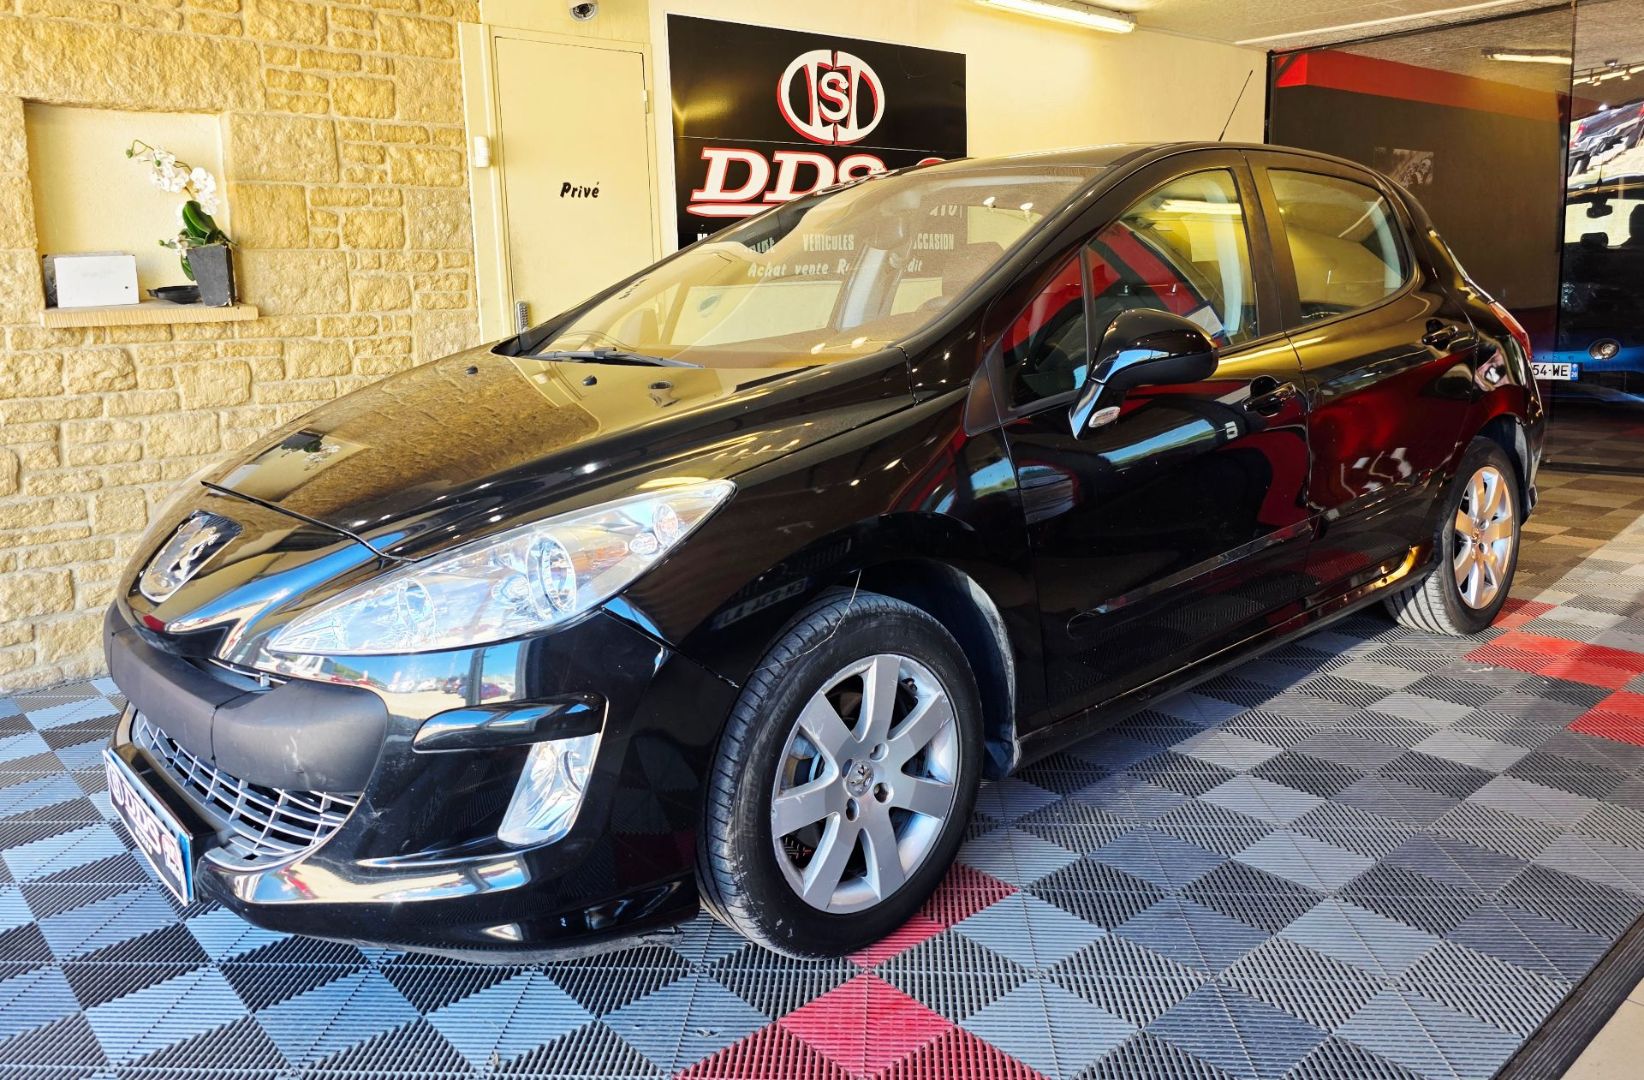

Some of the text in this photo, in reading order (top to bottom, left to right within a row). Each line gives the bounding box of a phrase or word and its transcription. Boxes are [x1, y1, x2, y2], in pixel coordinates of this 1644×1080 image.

[560, 181, 600, 198] Privé
[803, 233, 854, 251] VEHICULES
[747, 262, 787, 278] Achat
[795, 262, 829, 275] vente
